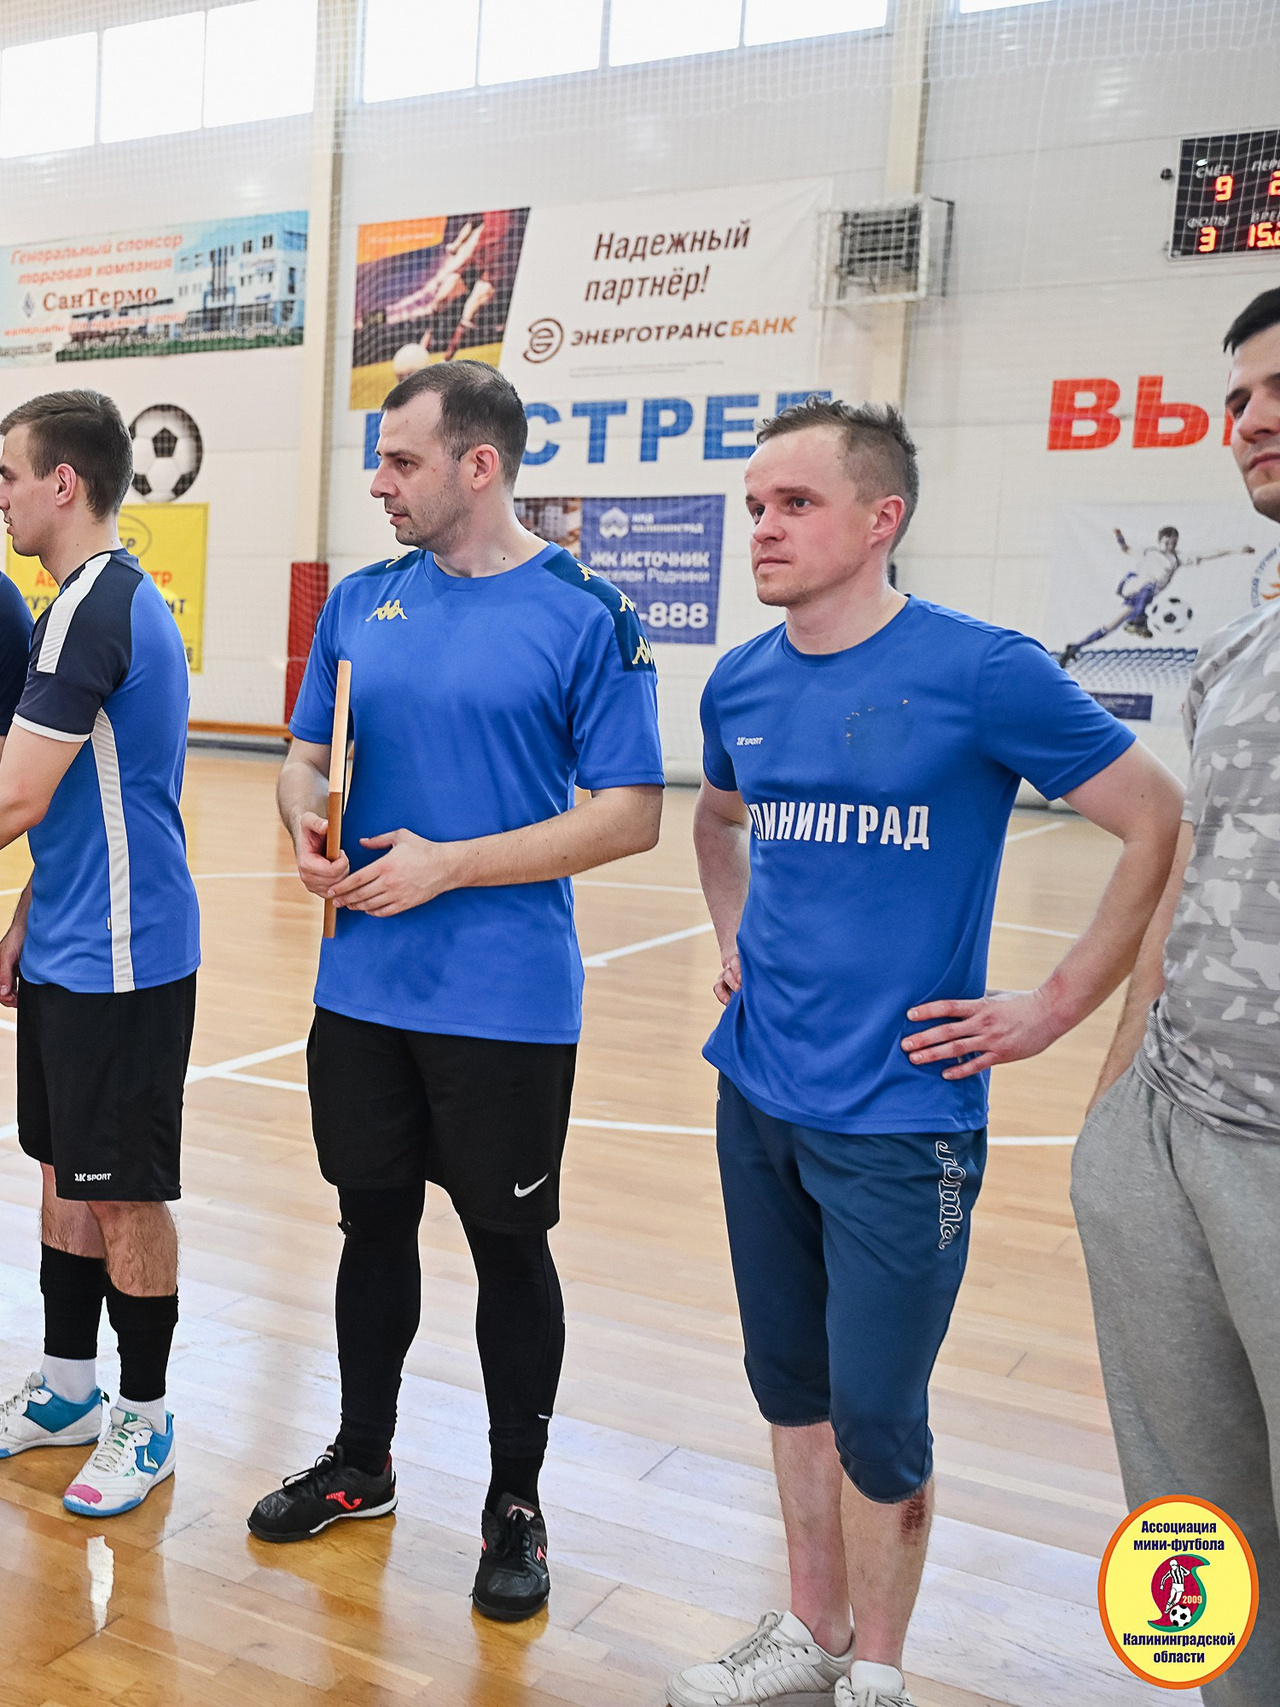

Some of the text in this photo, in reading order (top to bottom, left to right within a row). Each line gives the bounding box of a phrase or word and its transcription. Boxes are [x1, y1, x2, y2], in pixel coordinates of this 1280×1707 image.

[1215, 175, 1233, 201] 9
[10, 235, 183, 264] Генеральный спонсор
[593, 220, 751, 265] Надежный
[1198, 226, 1217, 252] 3
[18, 258, 173, 286] торговая компания
[584, 265, 711, 305] партнёр!
[42, 286, 157, 311] СанТермо
[570, 315, 797, 347] ЭНЕРГОТРАНСБАНК
[364, 391, 832, 470] СТРЕ
[589, 551, 711, 568] ЖК ИСТОЧНИК
[596, 567, 711, 584] оселок Родники
[748, 801, 930, 850] ЛИНИНГРАД
[86, 1172, 112, 1182] SPORT
